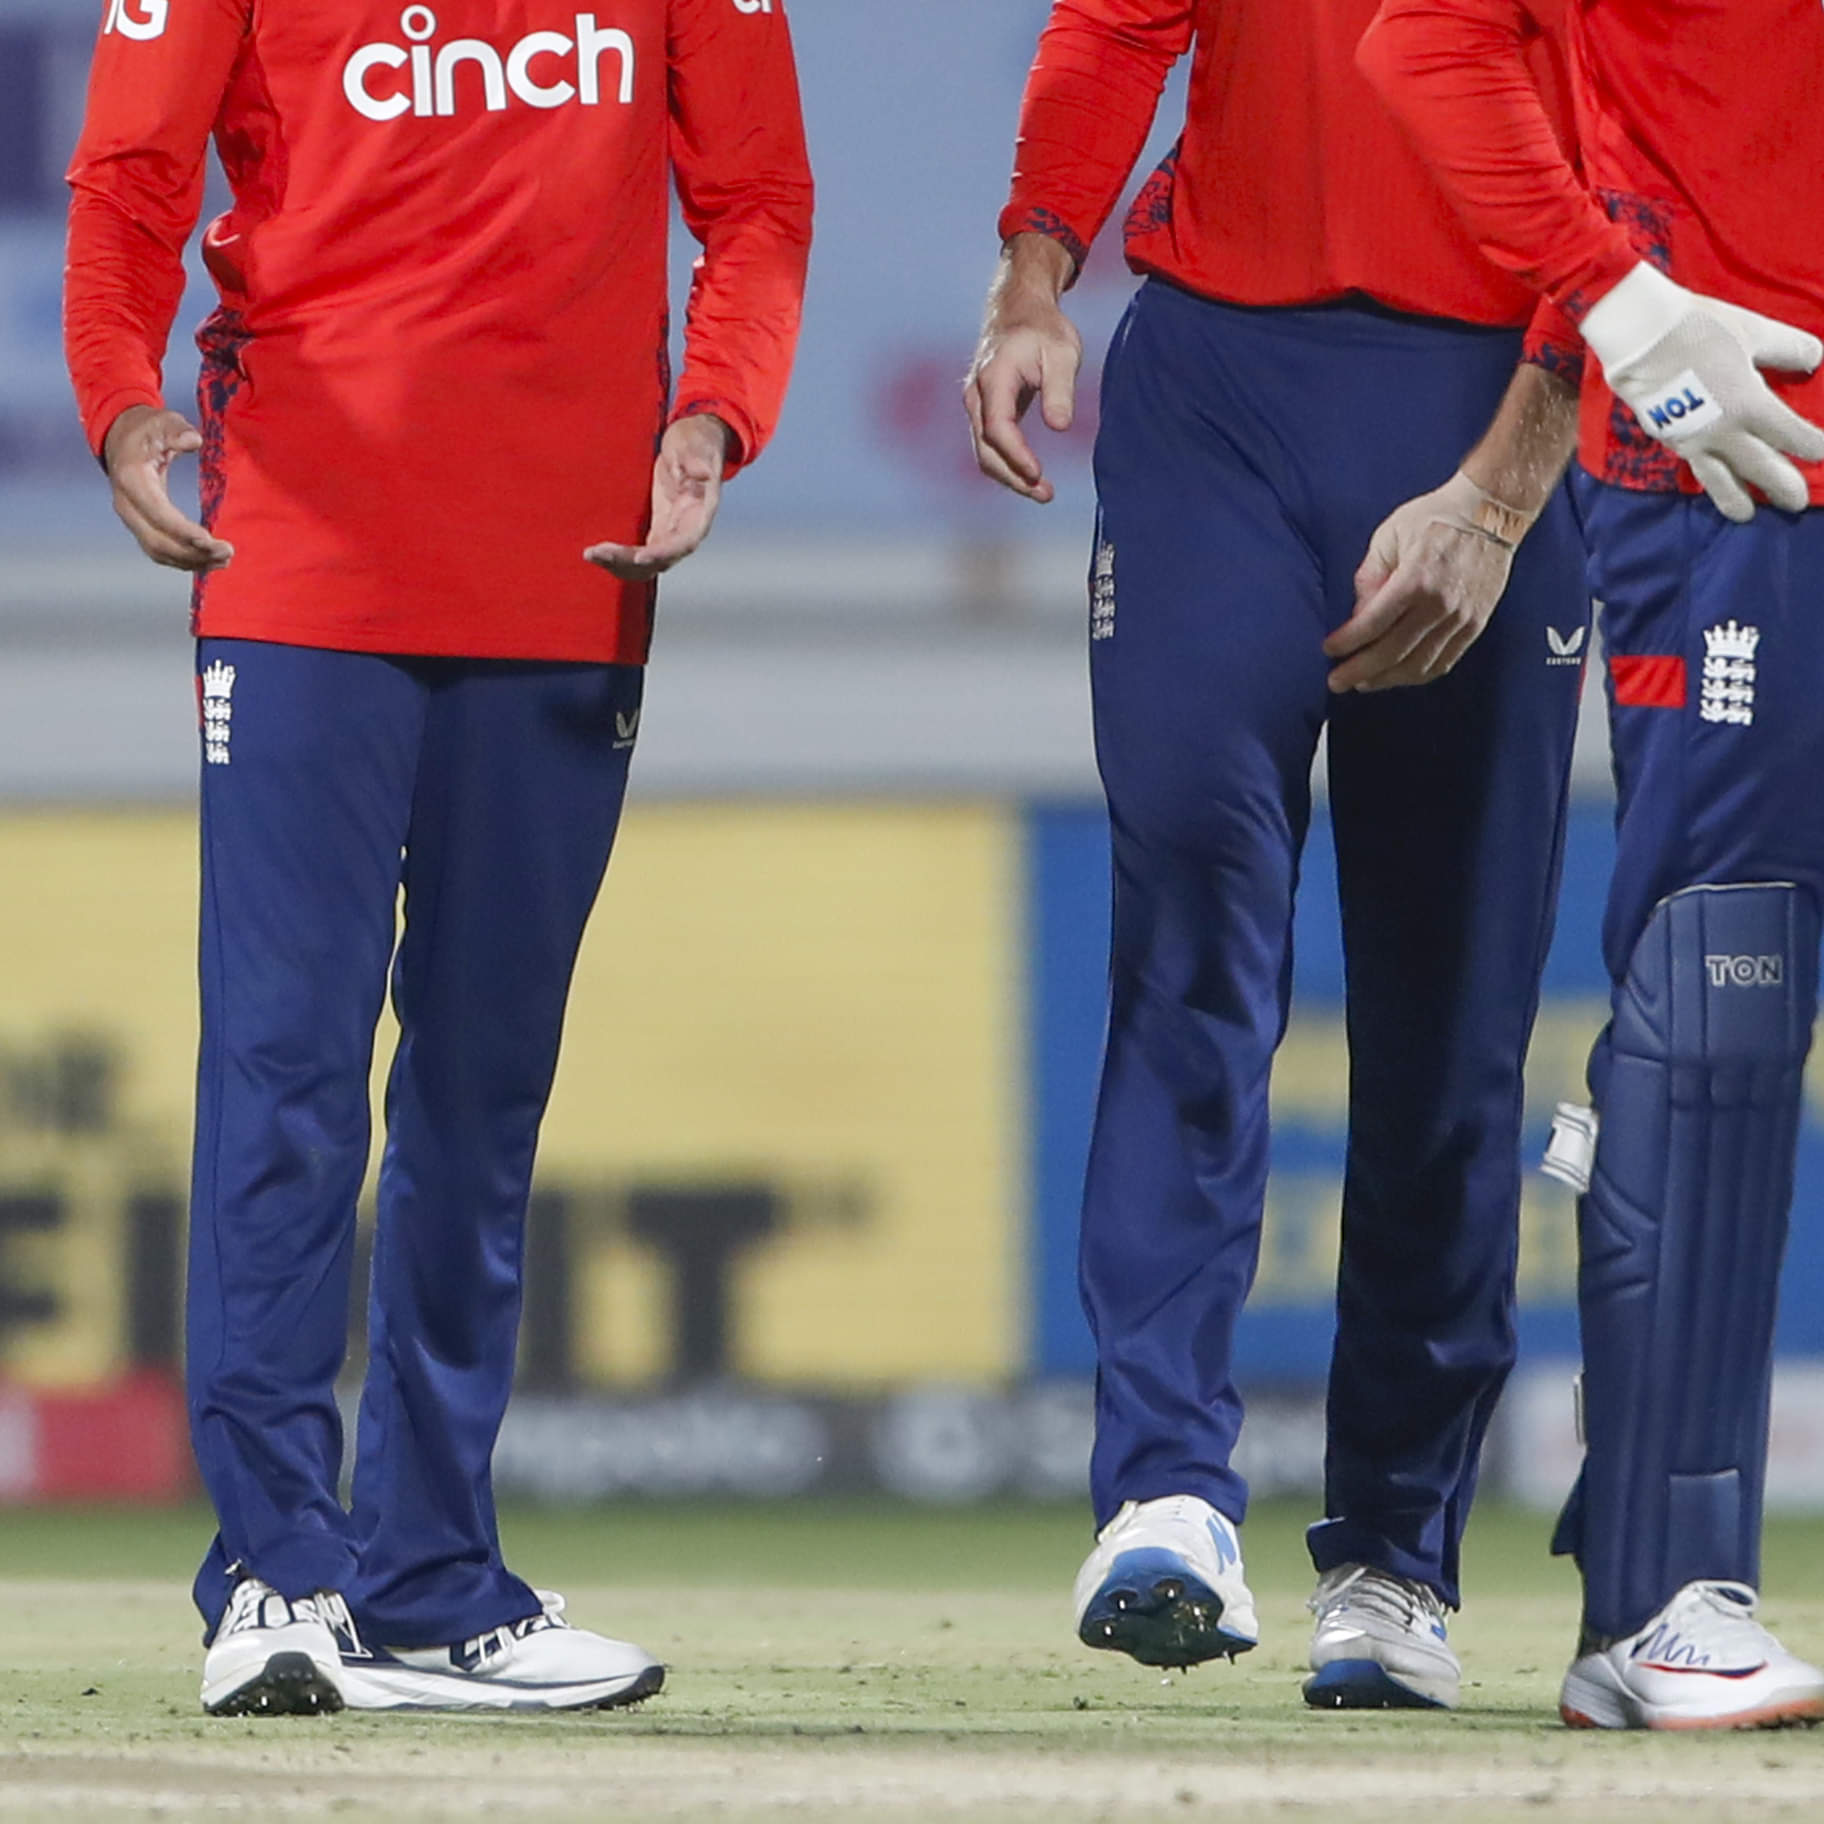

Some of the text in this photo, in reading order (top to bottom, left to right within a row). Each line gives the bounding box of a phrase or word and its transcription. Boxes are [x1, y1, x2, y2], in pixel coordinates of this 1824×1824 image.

[342, 3, 635, 121] cinch
[1647, 387, 1705, 430] TON
[1704, 954, 1783, 988] TON
